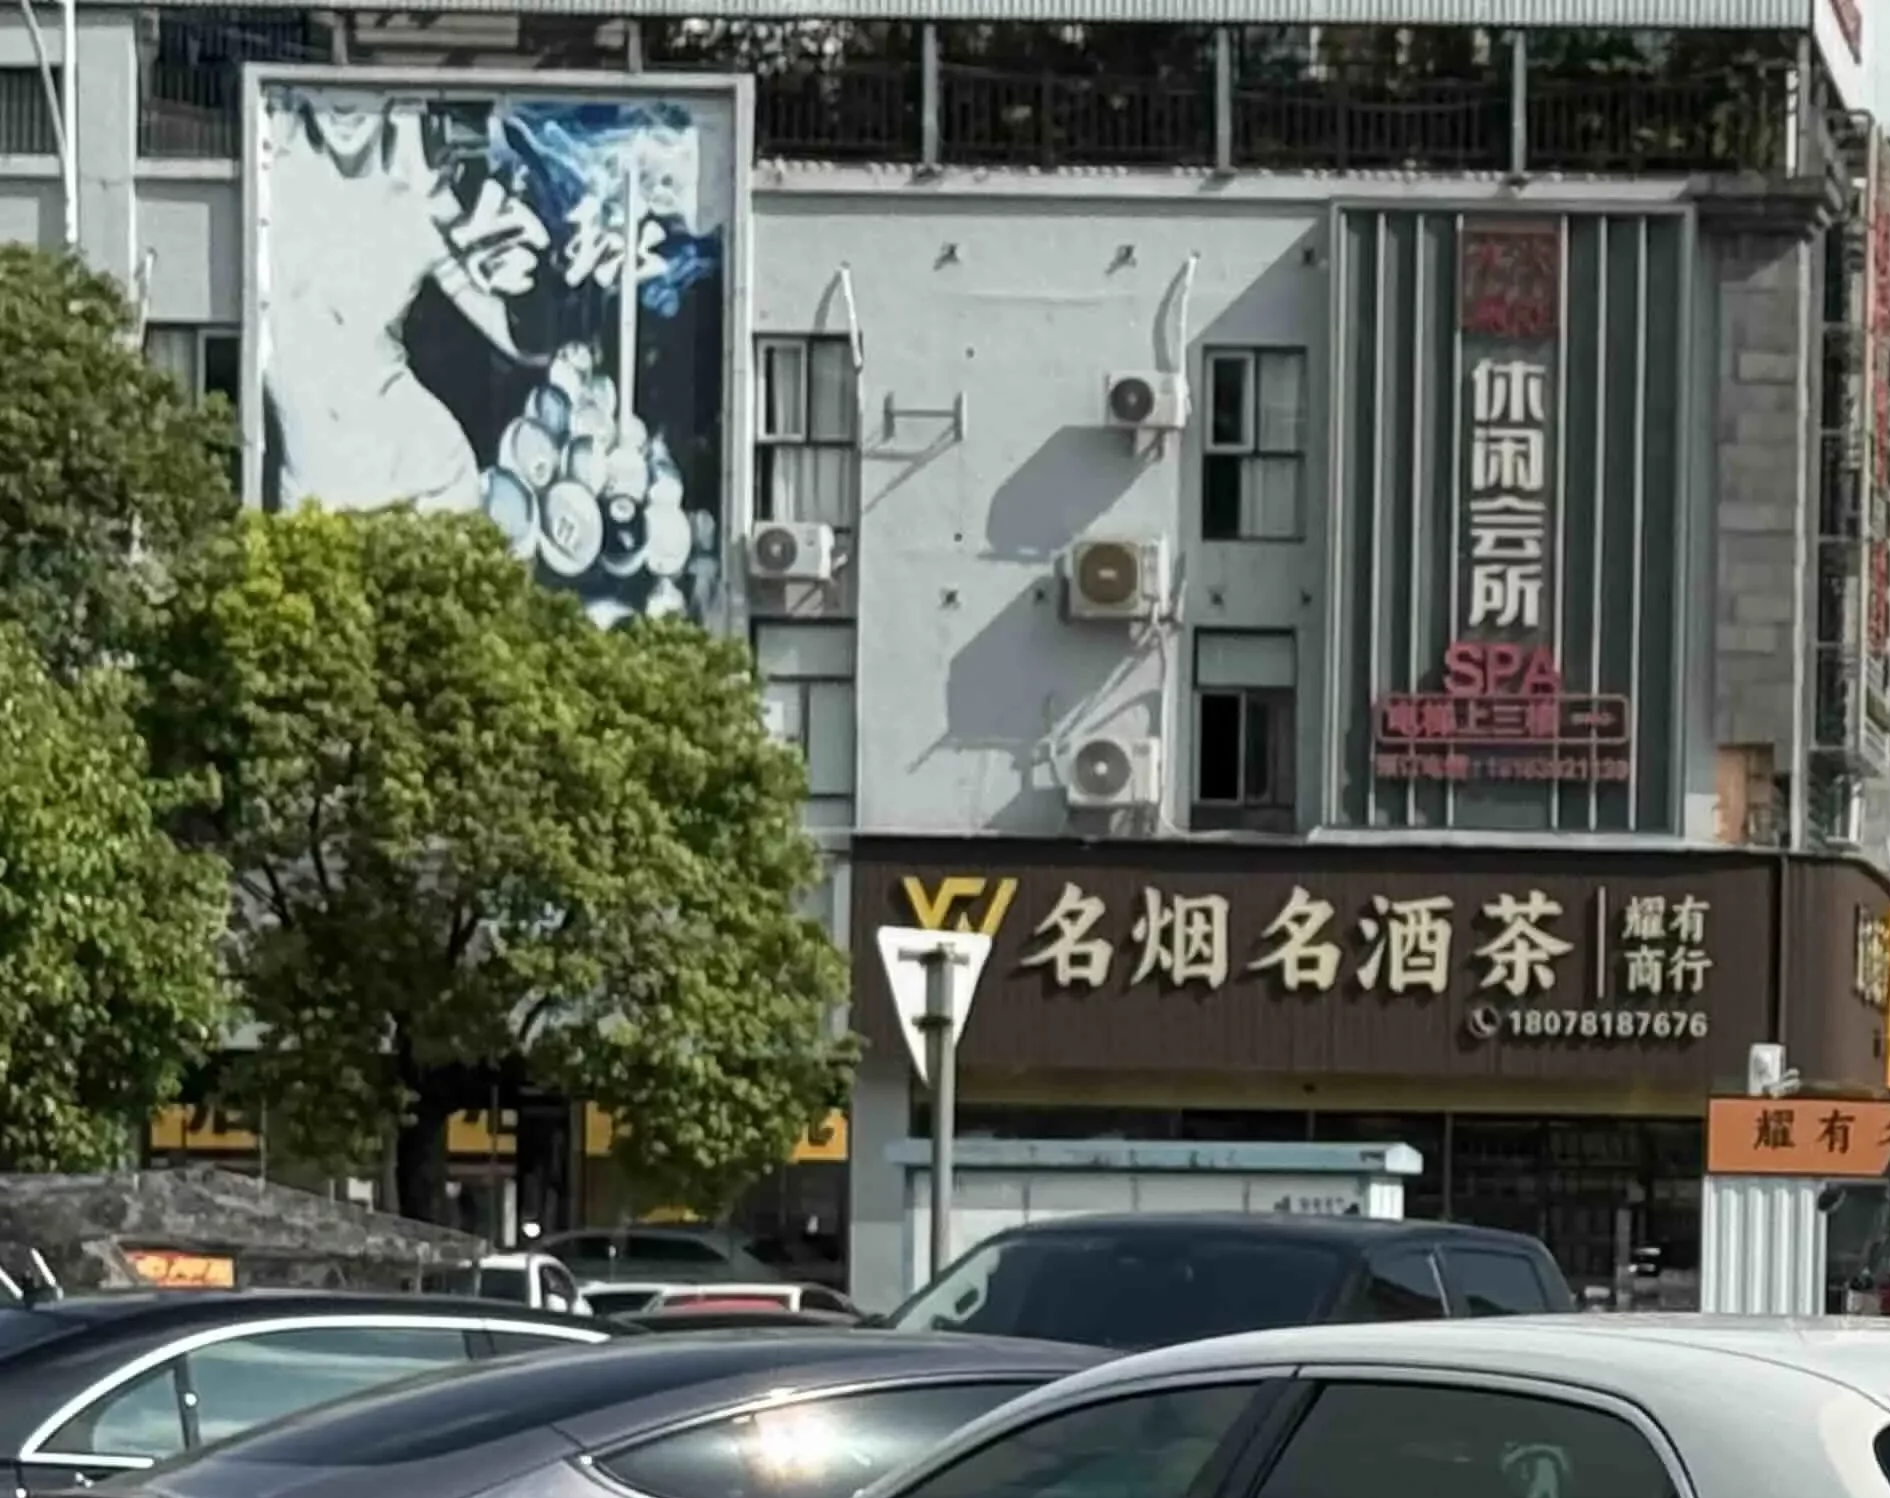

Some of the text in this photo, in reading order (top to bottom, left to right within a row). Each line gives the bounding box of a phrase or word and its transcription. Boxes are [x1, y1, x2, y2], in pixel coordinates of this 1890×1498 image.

[1469, 357, 1546, 628] 休闲会所
[1443, 643, 1562, 696] SPA
[1019, 881, 1575, 998] 名烟名酒茶
[1621, 893, 1711, 943] 耀有
[1622, 944, 1713, 995] 商行
[1508, 1009, 1709, 1039] 18078187676
